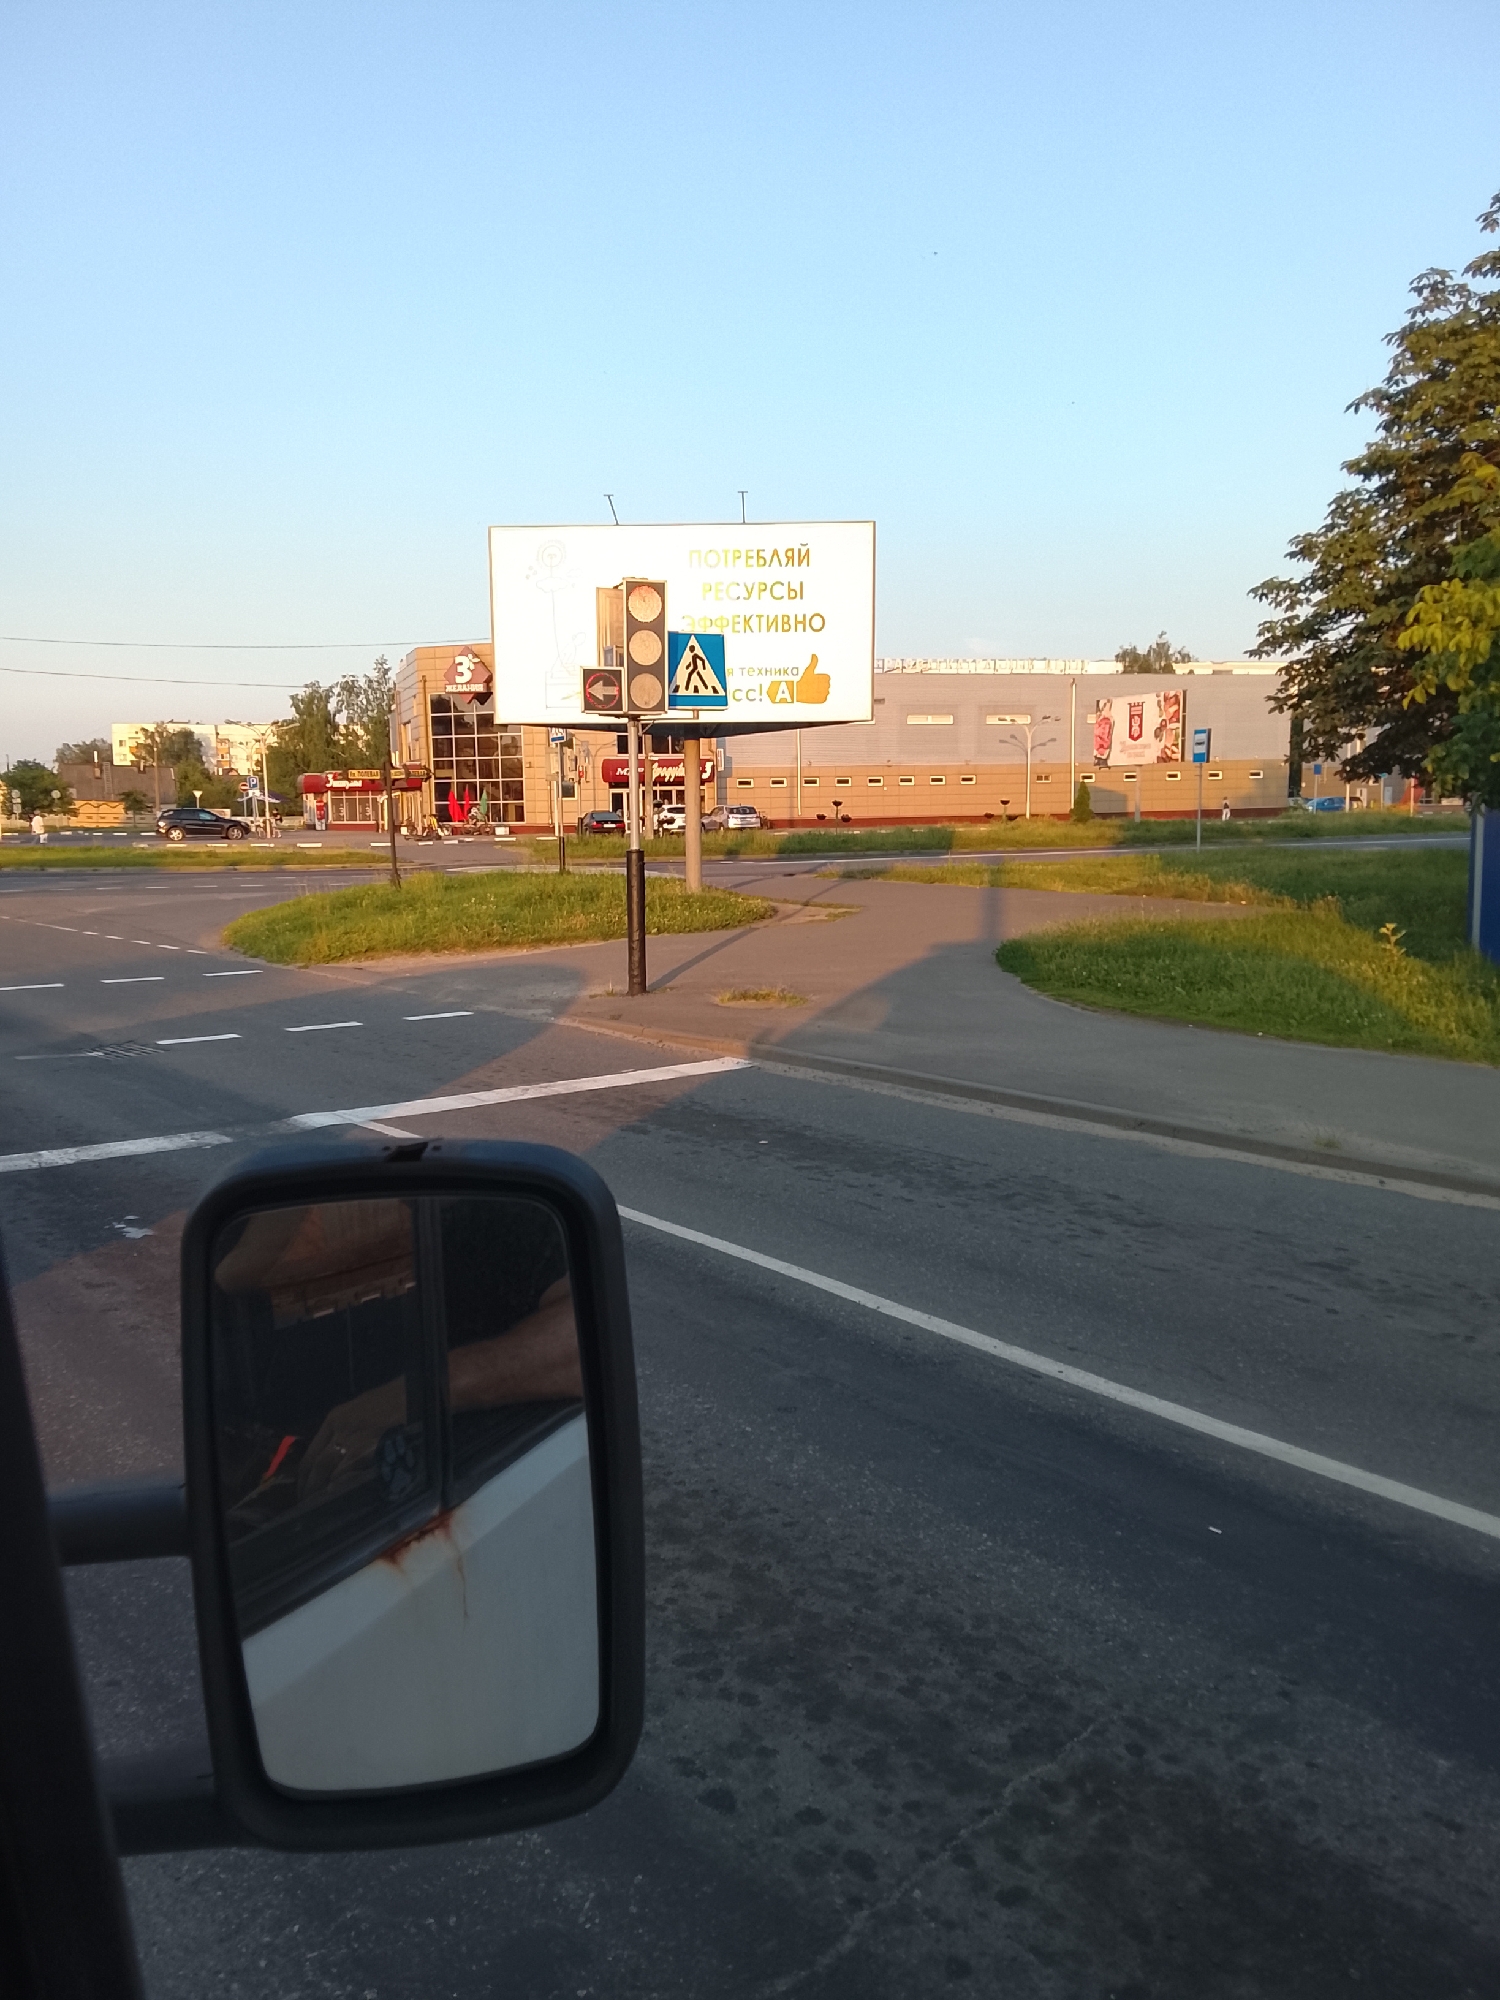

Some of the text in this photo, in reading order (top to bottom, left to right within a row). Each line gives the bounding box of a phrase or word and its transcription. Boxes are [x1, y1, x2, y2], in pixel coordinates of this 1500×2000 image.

[689, 543, 810, 568] ПОТРЕБЛЯЙ
[702, 581, 804, 601] РЕСУРСЫ
[681, 613, 826, 633] ЭФФЕКТИВНО
[740, 666, 799, 677] техника
